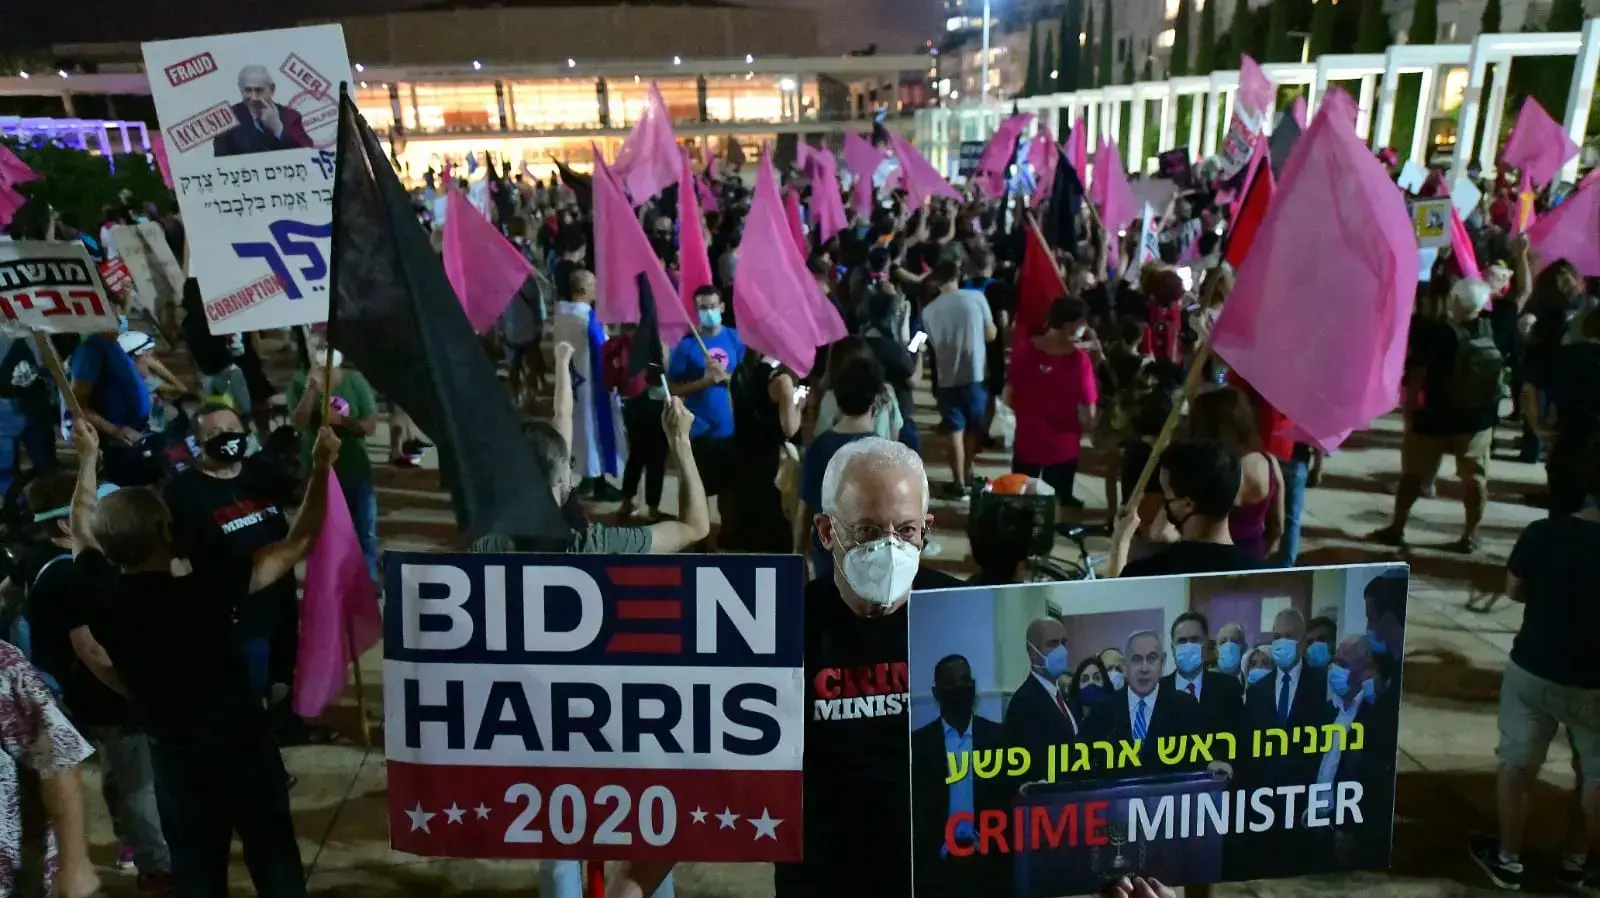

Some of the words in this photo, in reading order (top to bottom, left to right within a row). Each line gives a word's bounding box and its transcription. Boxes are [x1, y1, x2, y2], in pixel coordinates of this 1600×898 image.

[168, 56, 214, 84] FRAUD
[288, 61, 324, 91] LIER
[176, 107, 234, 147] ACCUSED
[206, 276, 284, 321] CORRUPTION
[401, 563, 777, 655] BIDEN
[403, 678, 782, 757] HARRIS
[1047, 738, 1143, 784] ארגון
[1157, 731, 1237, 765] ראש
[1252, 722, 1365, 758] נתניהו
[945, 746, 1032, 785] פשע
[503, 782, 678, 847] 2020
[944, 800, 1111, 857] CRIME
[1127, 780, 1364, 843] MINISTER
